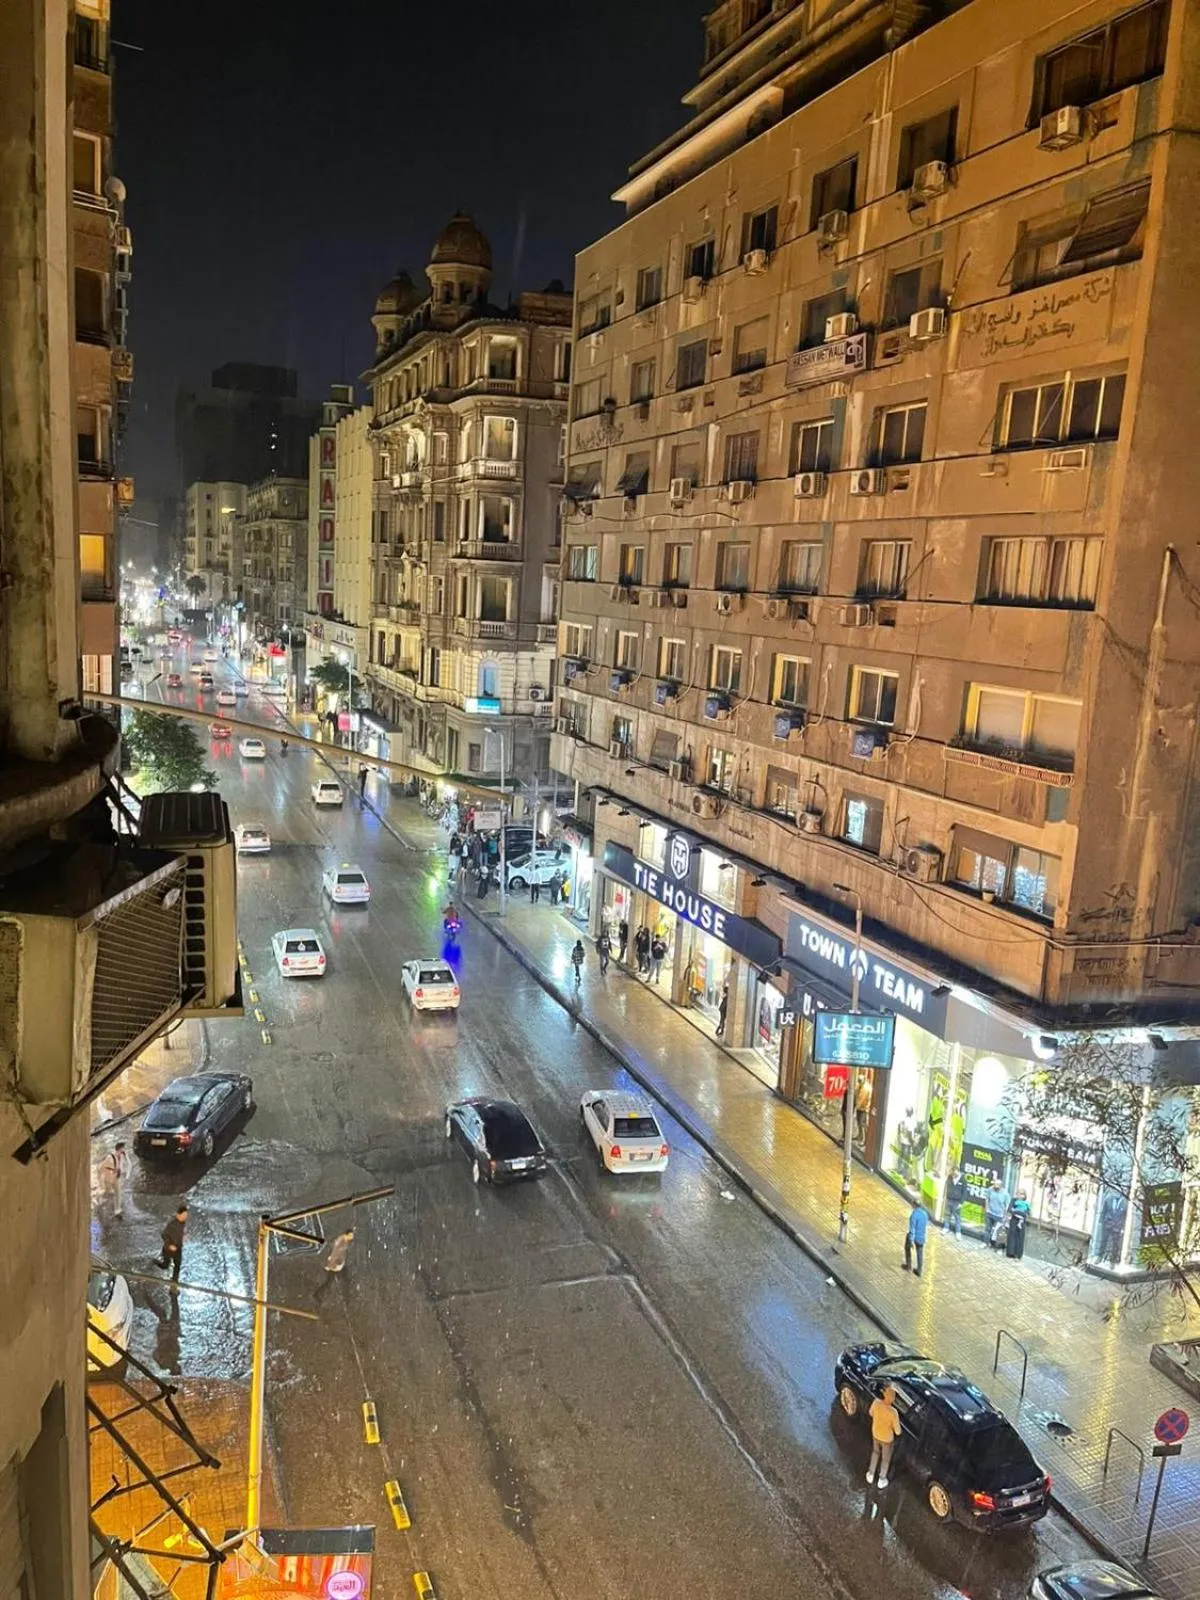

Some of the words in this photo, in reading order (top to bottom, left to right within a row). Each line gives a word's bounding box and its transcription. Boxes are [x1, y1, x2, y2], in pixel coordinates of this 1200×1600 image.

[633, 863, 658, 896] TIE
[663, 881, 726, 938] HOUSE
[800, 924, 846, 968] TOWN
[873, 964, 923, 1013] TEAM
[964, 1163, 990, 1176] BUY
[964, 1174, 989, 1185] GET
